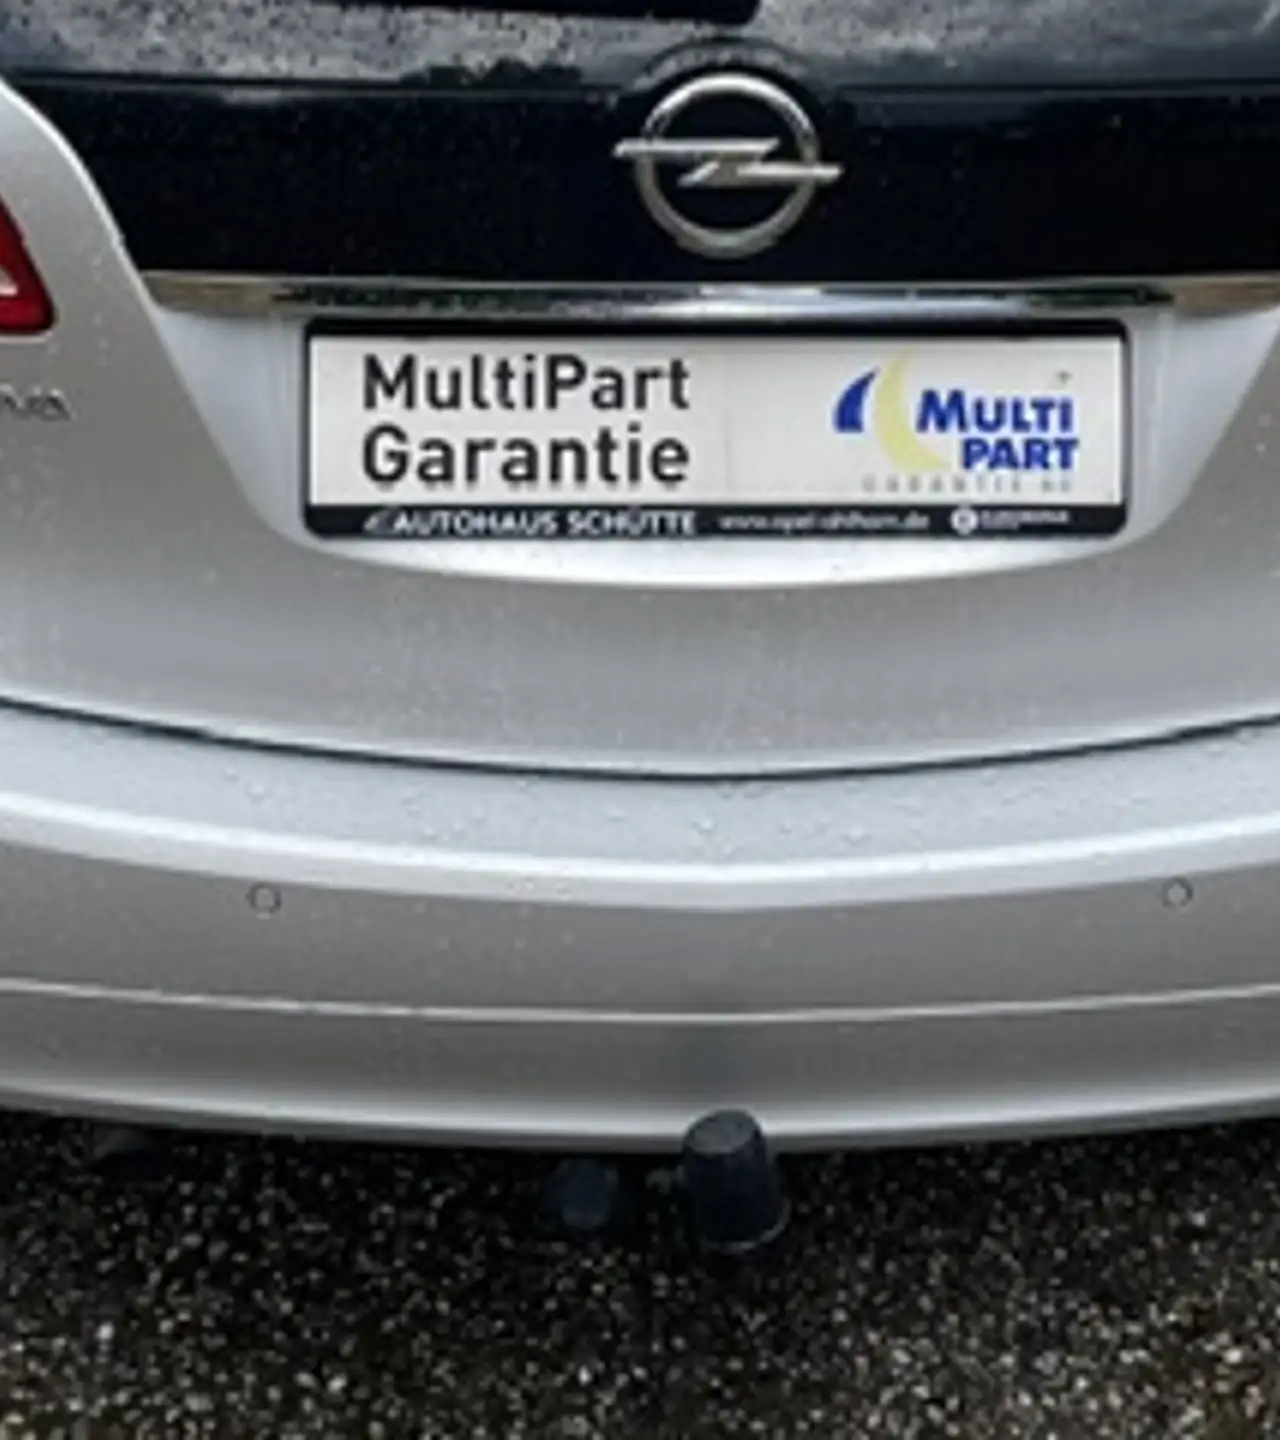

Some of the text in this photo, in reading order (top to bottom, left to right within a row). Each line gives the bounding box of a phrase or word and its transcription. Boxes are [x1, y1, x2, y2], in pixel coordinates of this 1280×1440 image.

[362, 352, 691, 411] MultiPart
[362, 420, 691, 485] Garantie
[961, 437, 1080, 470] PART
[394, 509, 558, 537] AUTOHAUS
[567, 505, 696, 537] SCHÜTTE
